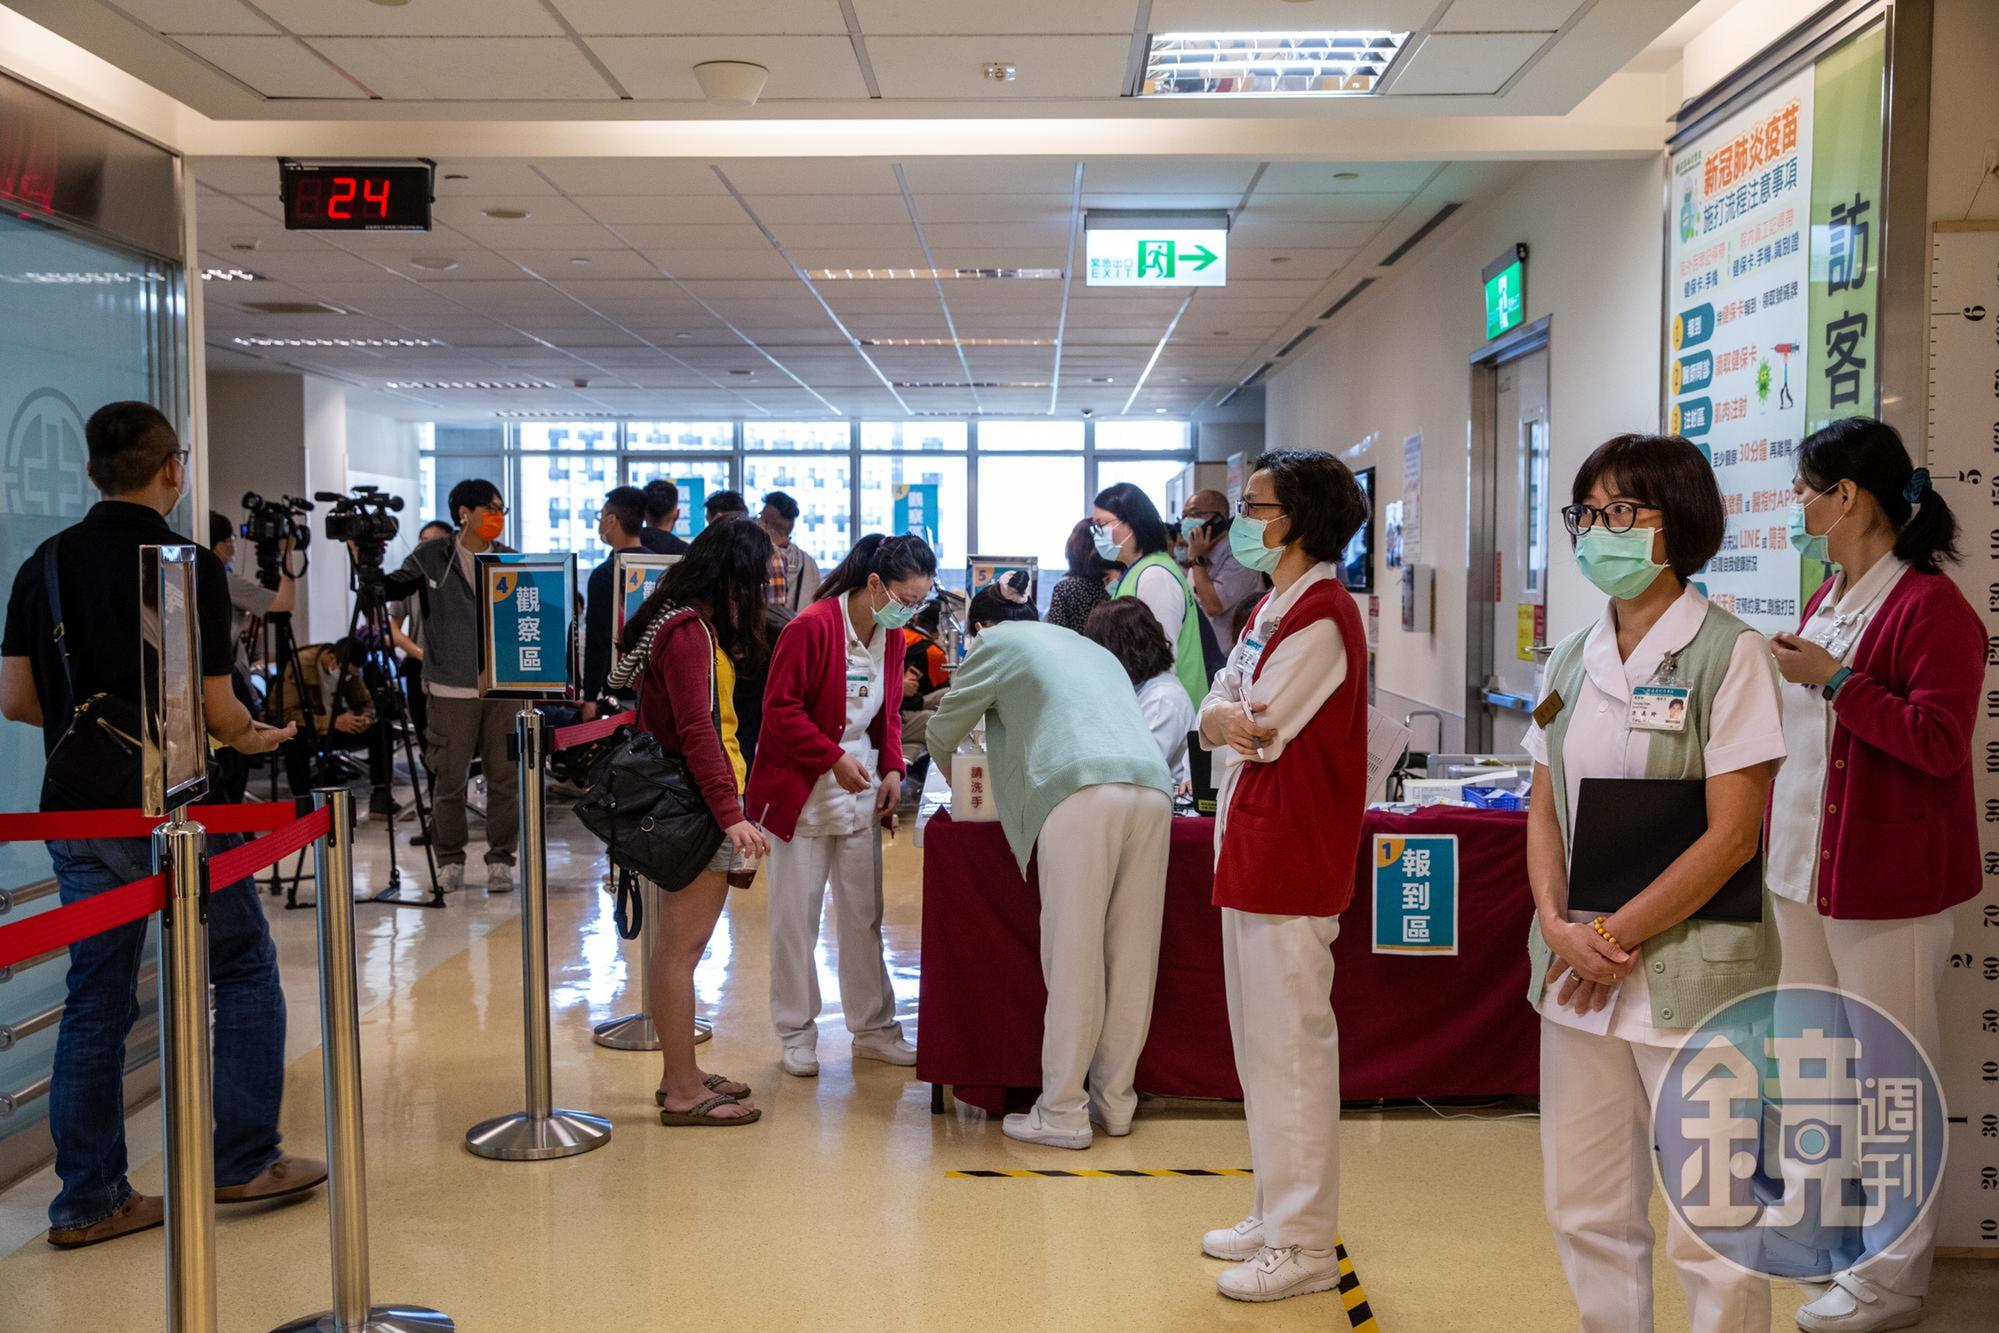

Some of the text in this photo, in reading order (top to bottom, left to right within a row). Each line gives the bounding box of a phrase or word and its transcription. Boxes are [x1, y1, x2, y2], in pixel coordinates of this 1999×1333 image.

[1703, 103, 1799, 197] 新冠肺炎疫苗
[328, 177, 390, 219] 24
[1703, 156, 1798, 234] 施打流程注意事項
[1091, 269, 1132, 279] EXIT
[1825, 192, 1870, 410] 訪客
[1963, 305, 1986, 321] 6
[1959, 469, 1981, 485] 5
[1740, 528, 1760, 549] LINE
[496, 576, 508, 593] 4
[516, 586, 542, 671] 觀察區
[1985, 741, 1999, 773] 100
[971, 766, 983, 809] 請洗手
[1985, 799, 1999, 823] 90
[1382, 842, 1391, 860] 1
[1984, 851, 1999, 875] 80
[1402, 848, 1431, 942] 報到區
[1983, 904, 1999, 928] 70
[1950, 954, 1973, 968] 2
[1983, 957, 1999, 980] 60
[1982, 1009, 1999, 1033] 50
[1981, 1061, 1999, 1086] 40
[1981, 1114, 1999, 1138] 30
[1981, 1166, 1998, 1190] 20
[1981, 1219, 1998, 1240] 10
